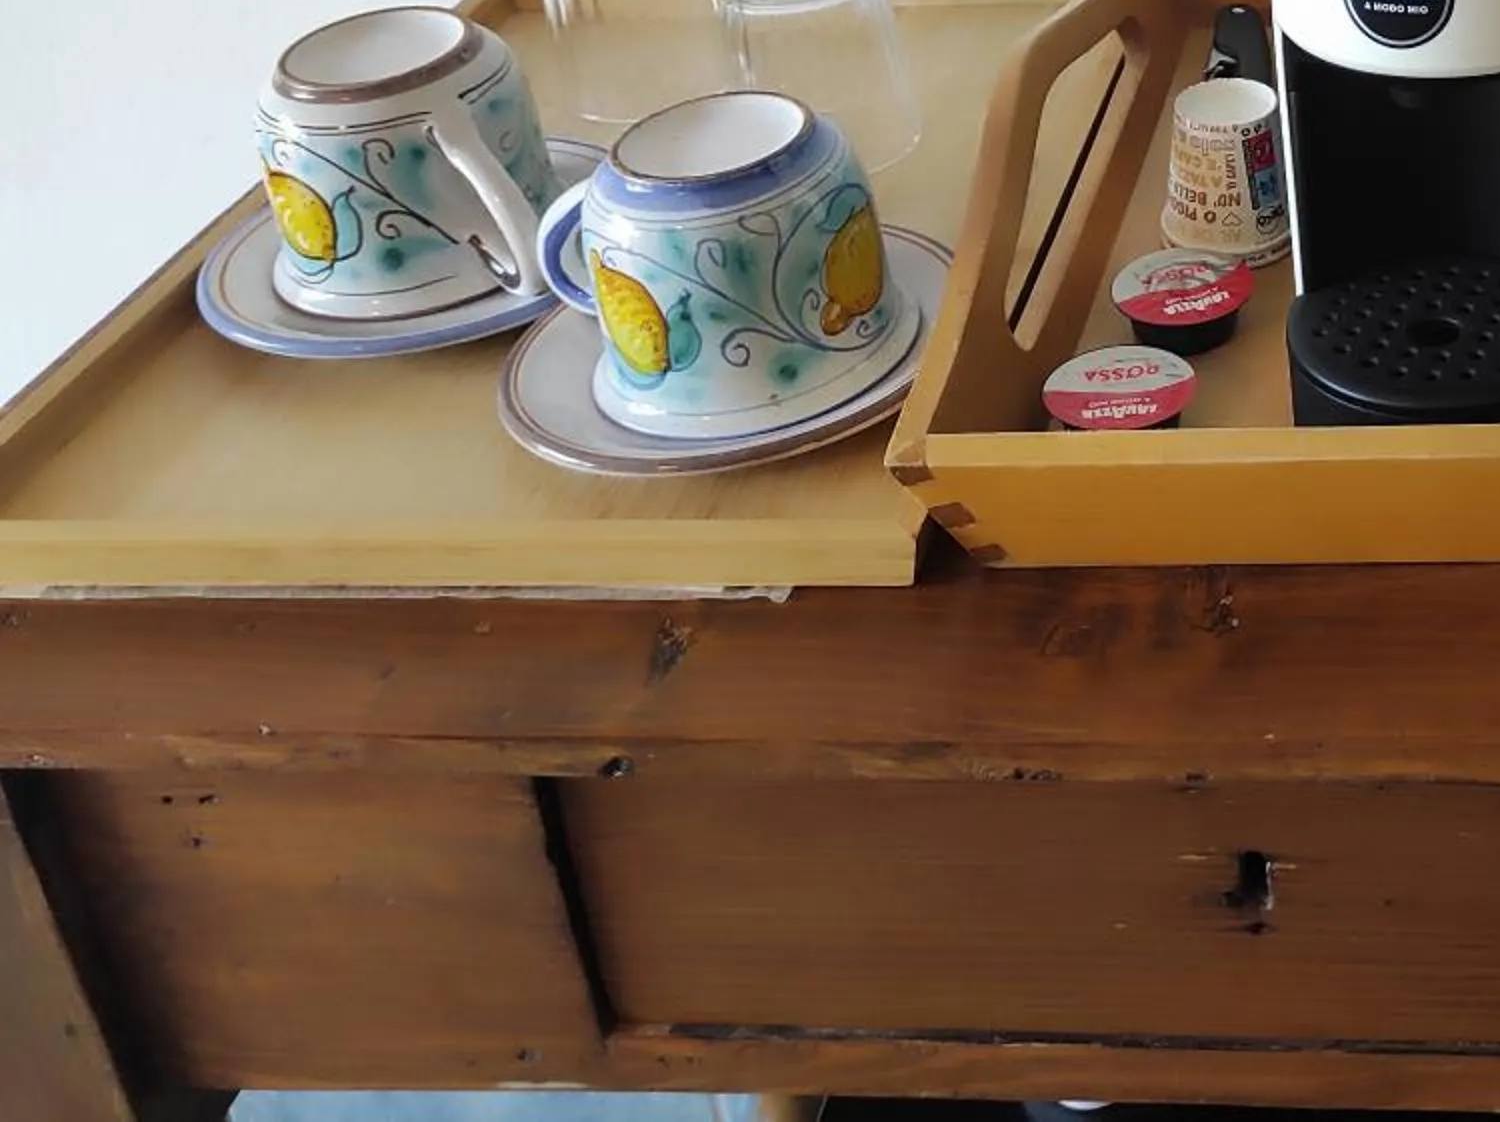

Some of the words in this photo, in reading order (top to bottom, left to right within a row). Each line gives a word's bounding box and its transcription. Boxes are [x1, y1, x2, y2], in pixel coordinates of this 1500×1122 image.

[1364, 1, 1371, 10] A
[1374, 2, 1405, 14] MODO
[1163, 290, 1230, 315] LAVAZZA
[1084, 364, 1160, 381] ROSSA
[1081, 403, 1158, 419] LAVAZZA
